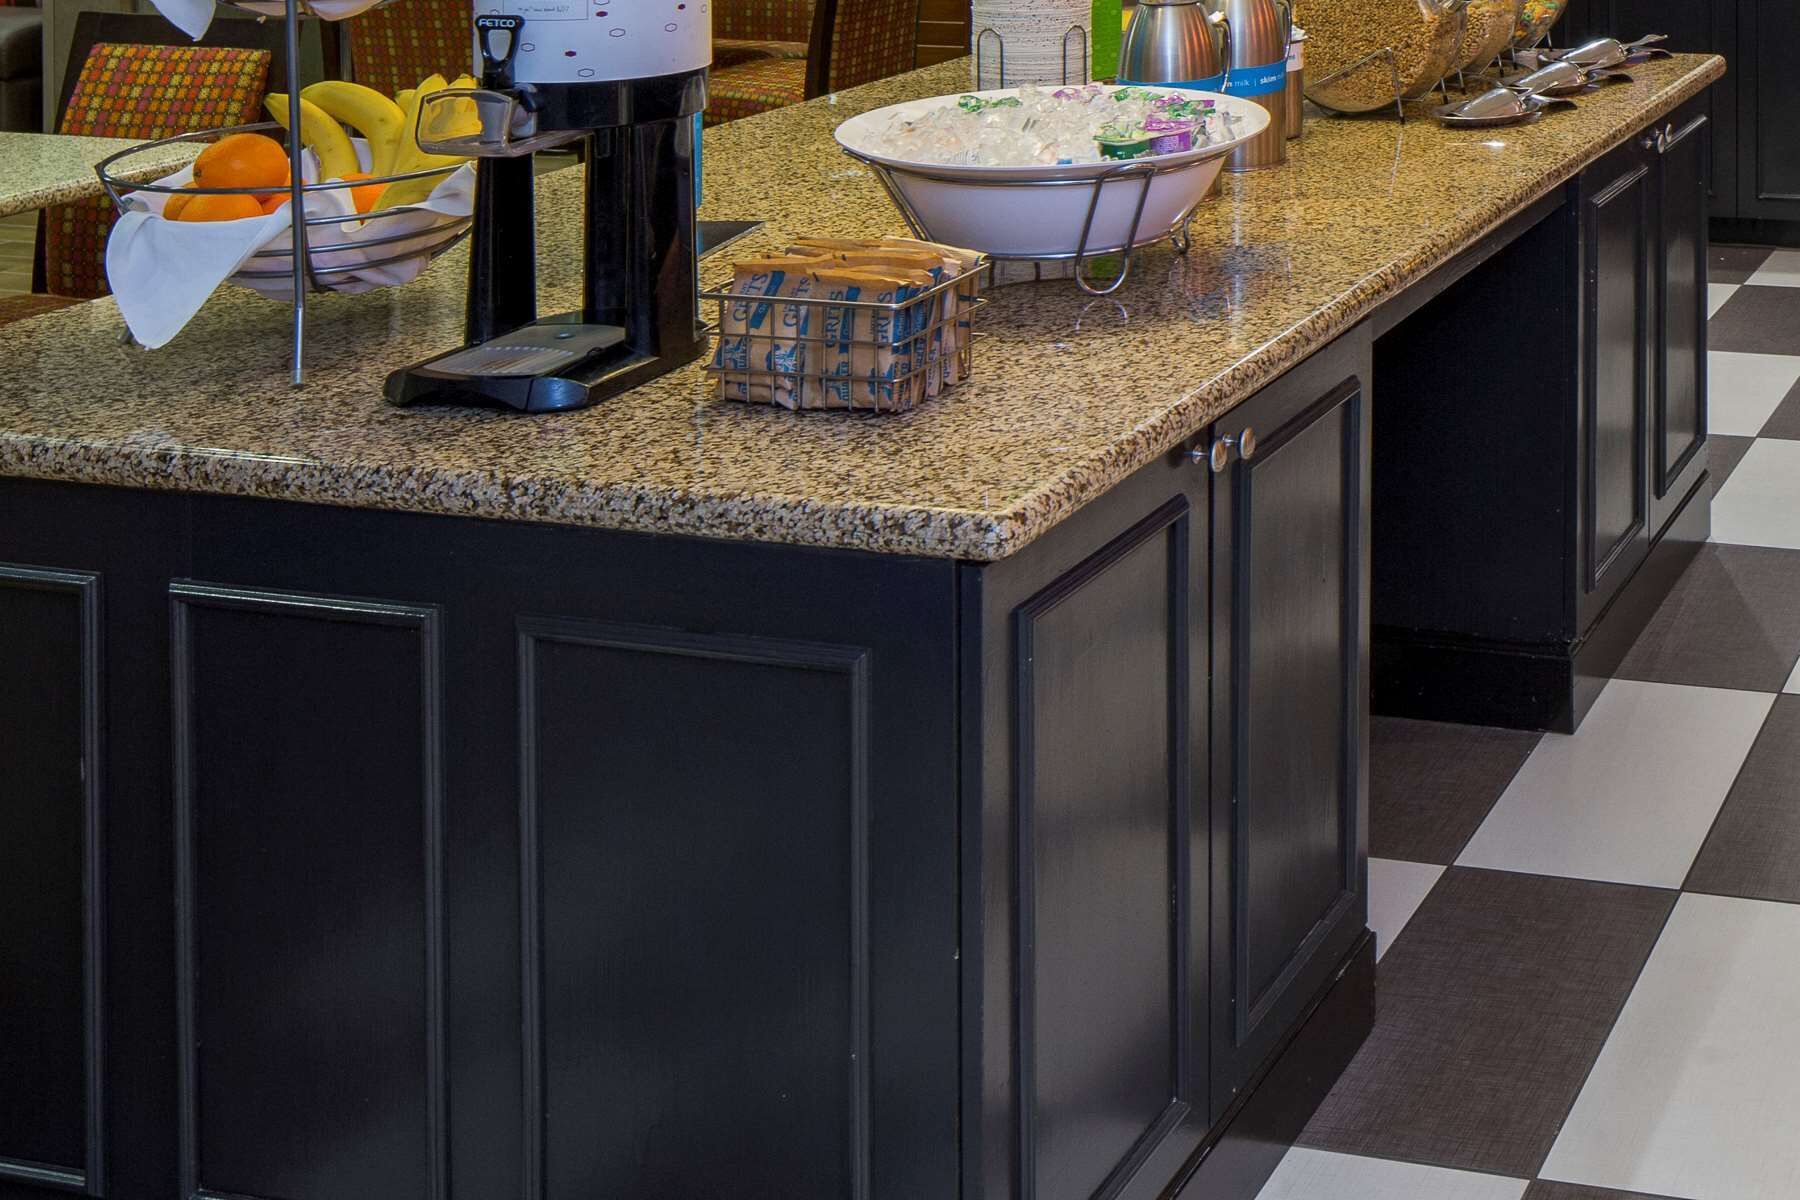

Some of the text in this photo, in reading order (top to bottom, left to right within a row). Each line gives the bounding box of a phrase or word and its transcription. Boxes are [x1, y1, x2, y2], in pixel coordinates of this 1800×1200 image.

[478, 18, 516, 28] FETCO
[1234, 79, 1250, 88] milk
[732, 273, 769, 322] GRTS
